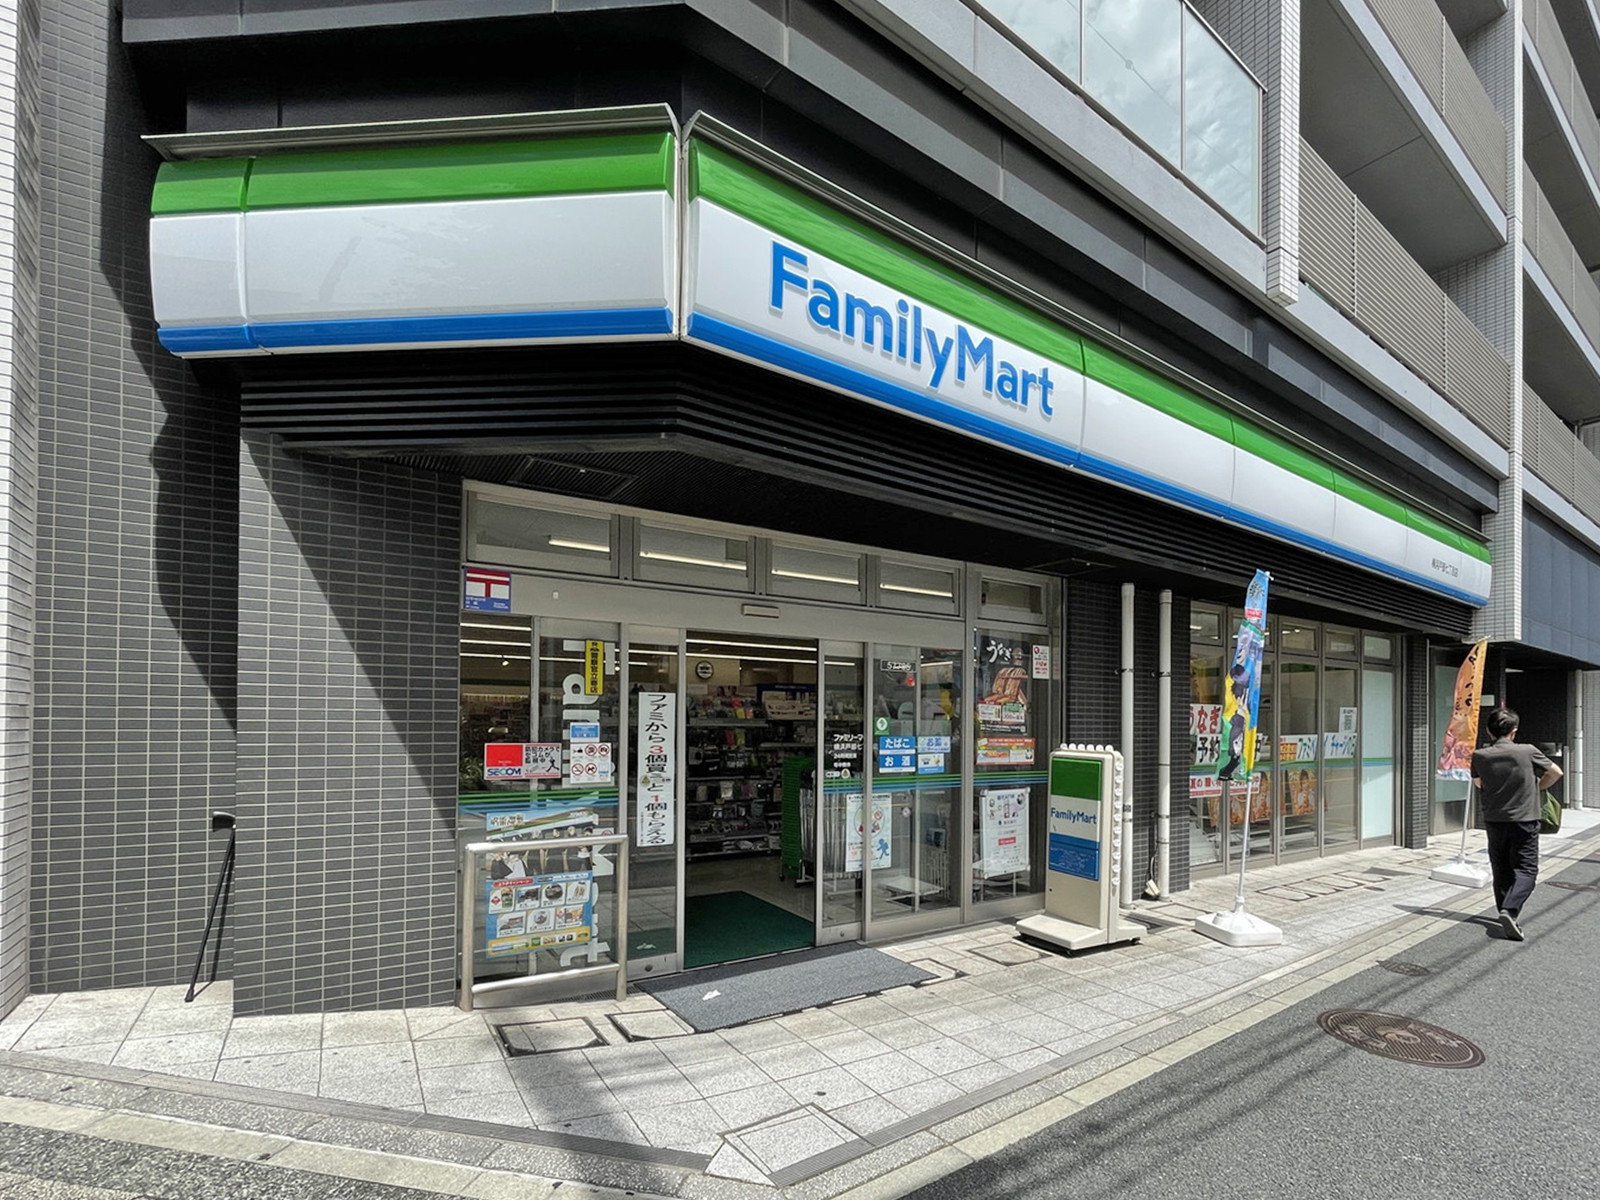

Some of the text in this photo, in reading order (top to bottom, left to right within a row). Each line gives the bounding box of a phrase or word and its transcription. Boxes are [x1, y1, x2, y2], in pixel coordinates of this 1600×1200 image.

[769, 240, 1054, 417] FamilyMart
[986, 640, 1012, 663] うなぎ
[885, 738, 910, 748] たばこ
[885, 756, 911, 766] お酒
[487, 768, 521, 776] SECOM
[1050, 807, 1097, 825] FamilyMart
